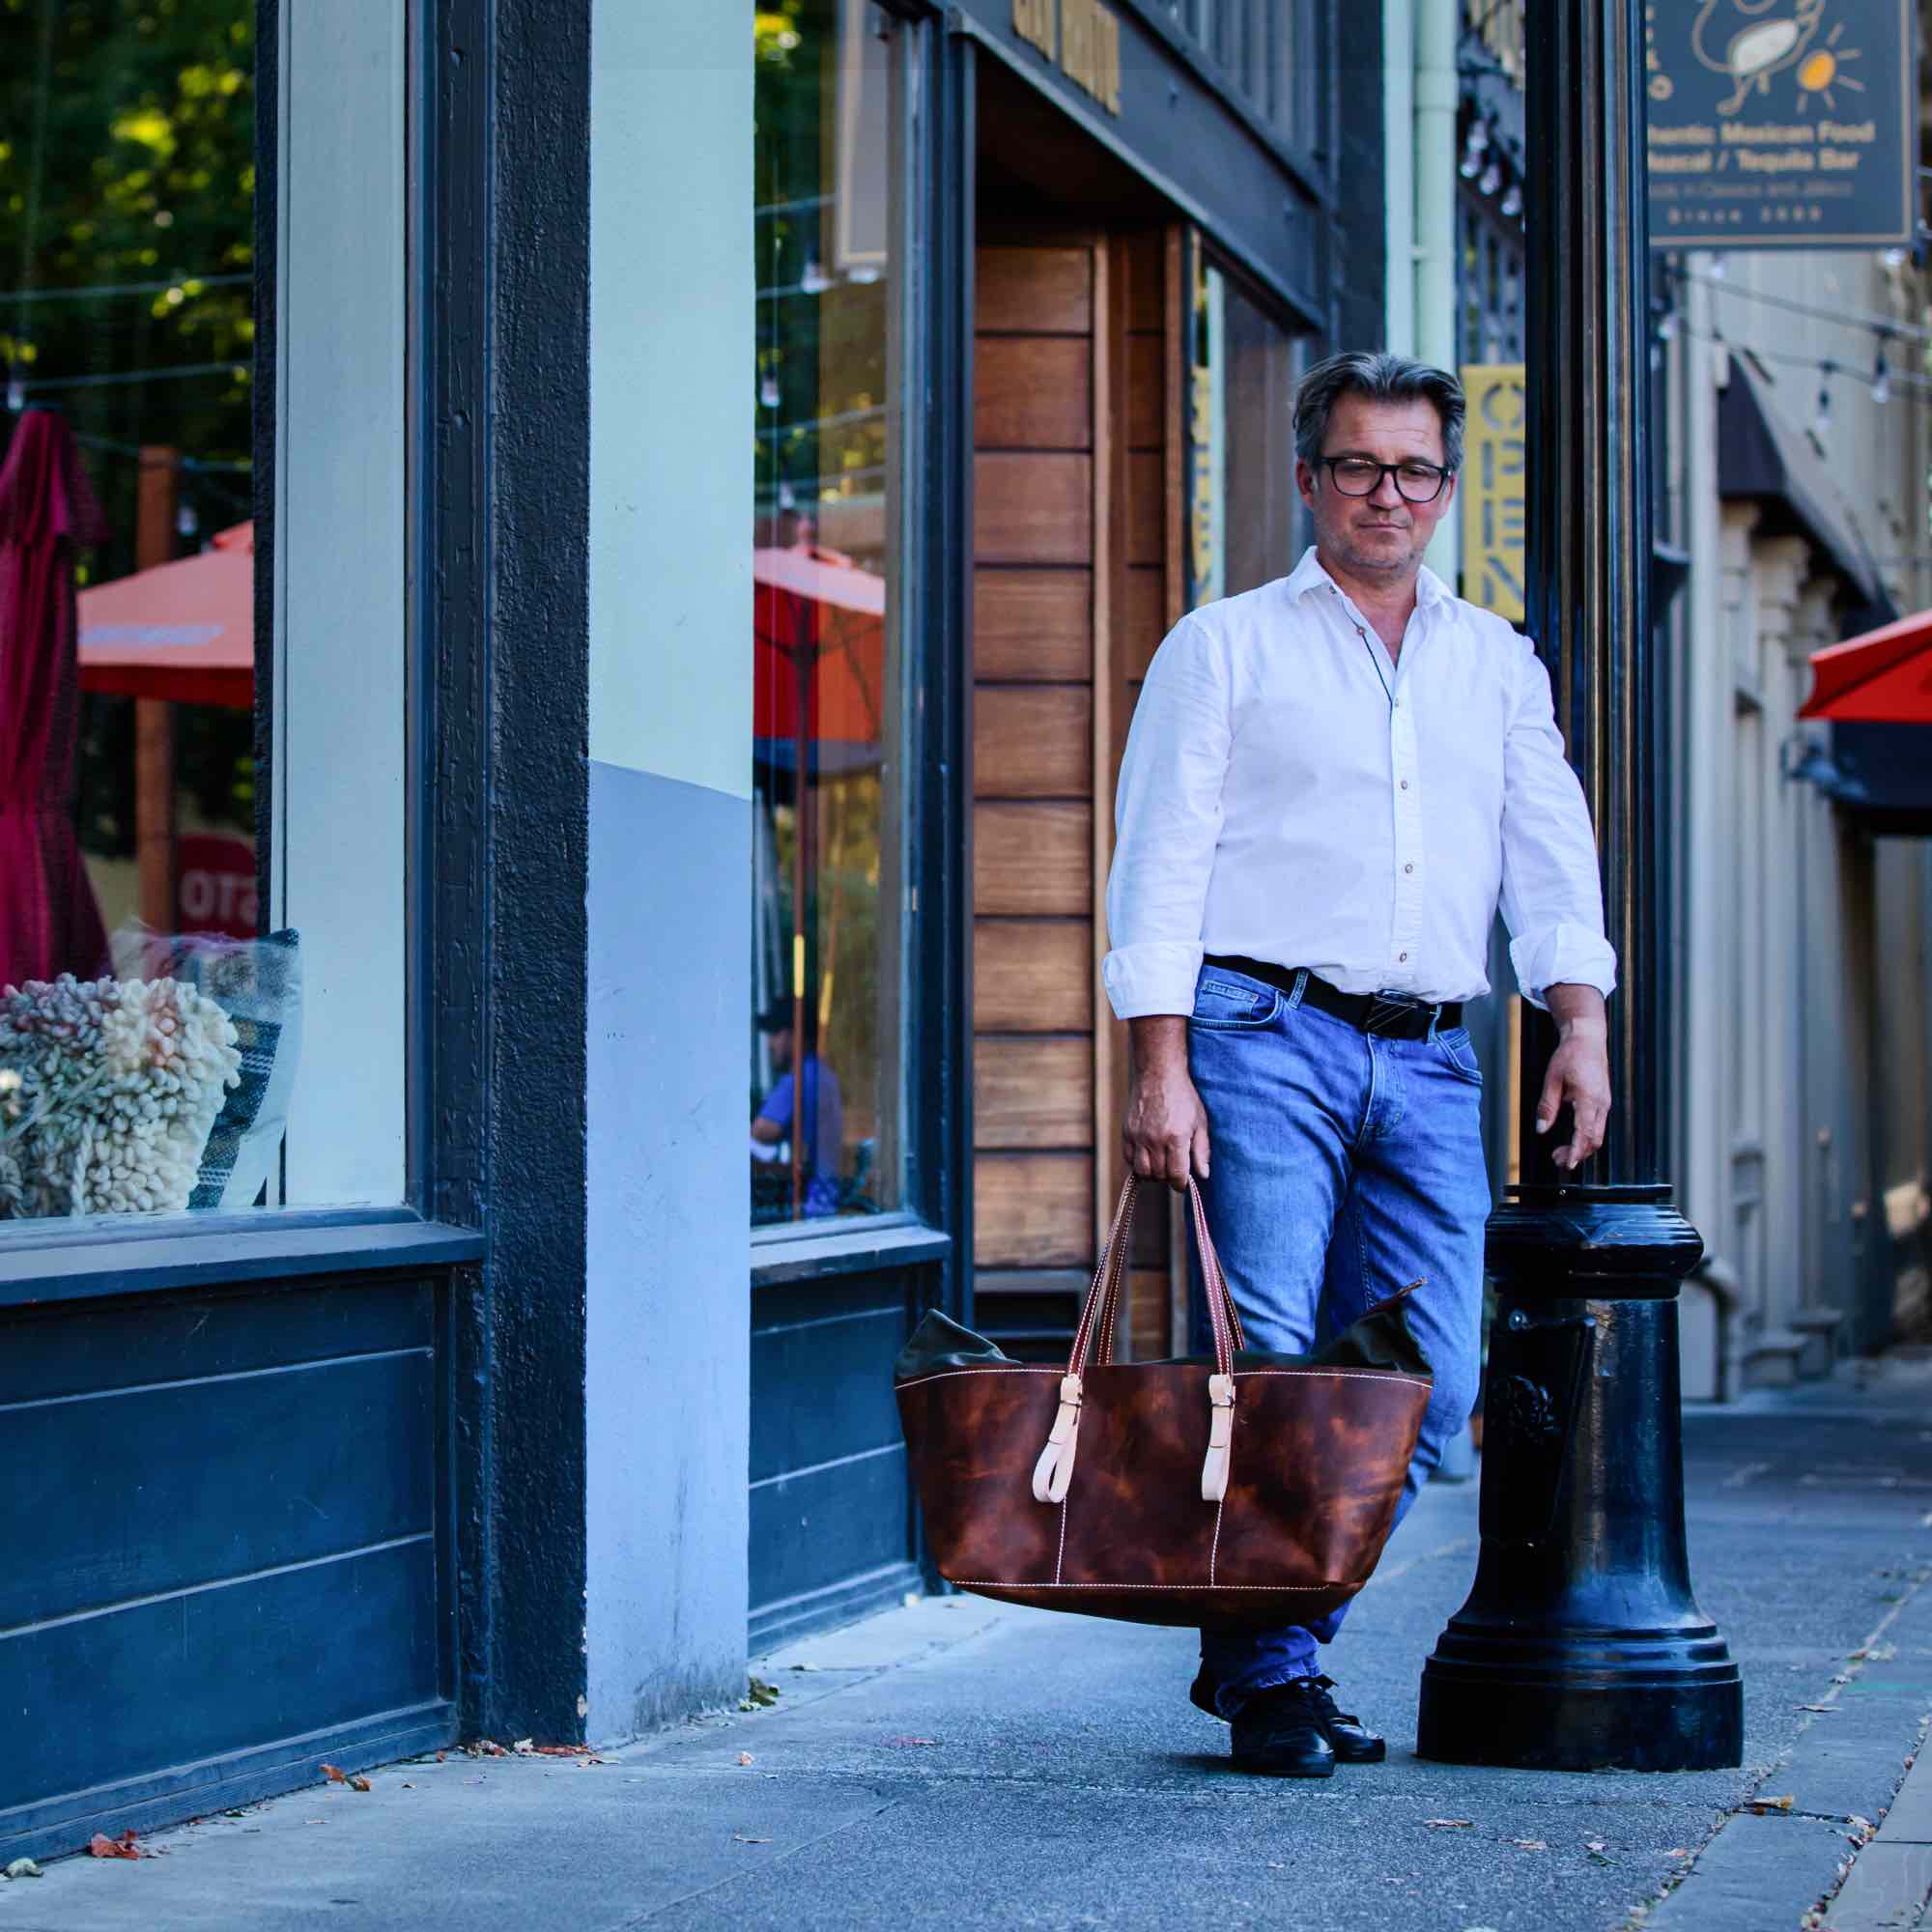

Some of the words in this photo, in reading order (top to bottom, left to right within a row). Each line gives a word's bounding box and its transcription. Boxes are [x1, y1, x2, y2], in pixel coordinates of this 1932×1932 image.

[1647, 124, 1716, 144] hentic
[1720, 122, 1814, 143] Mexican
[1818, 120, 1876, 142] Food
[1736, 149, 1814, 173] Tequila
[1819, 149, 1860, 170] Bar
